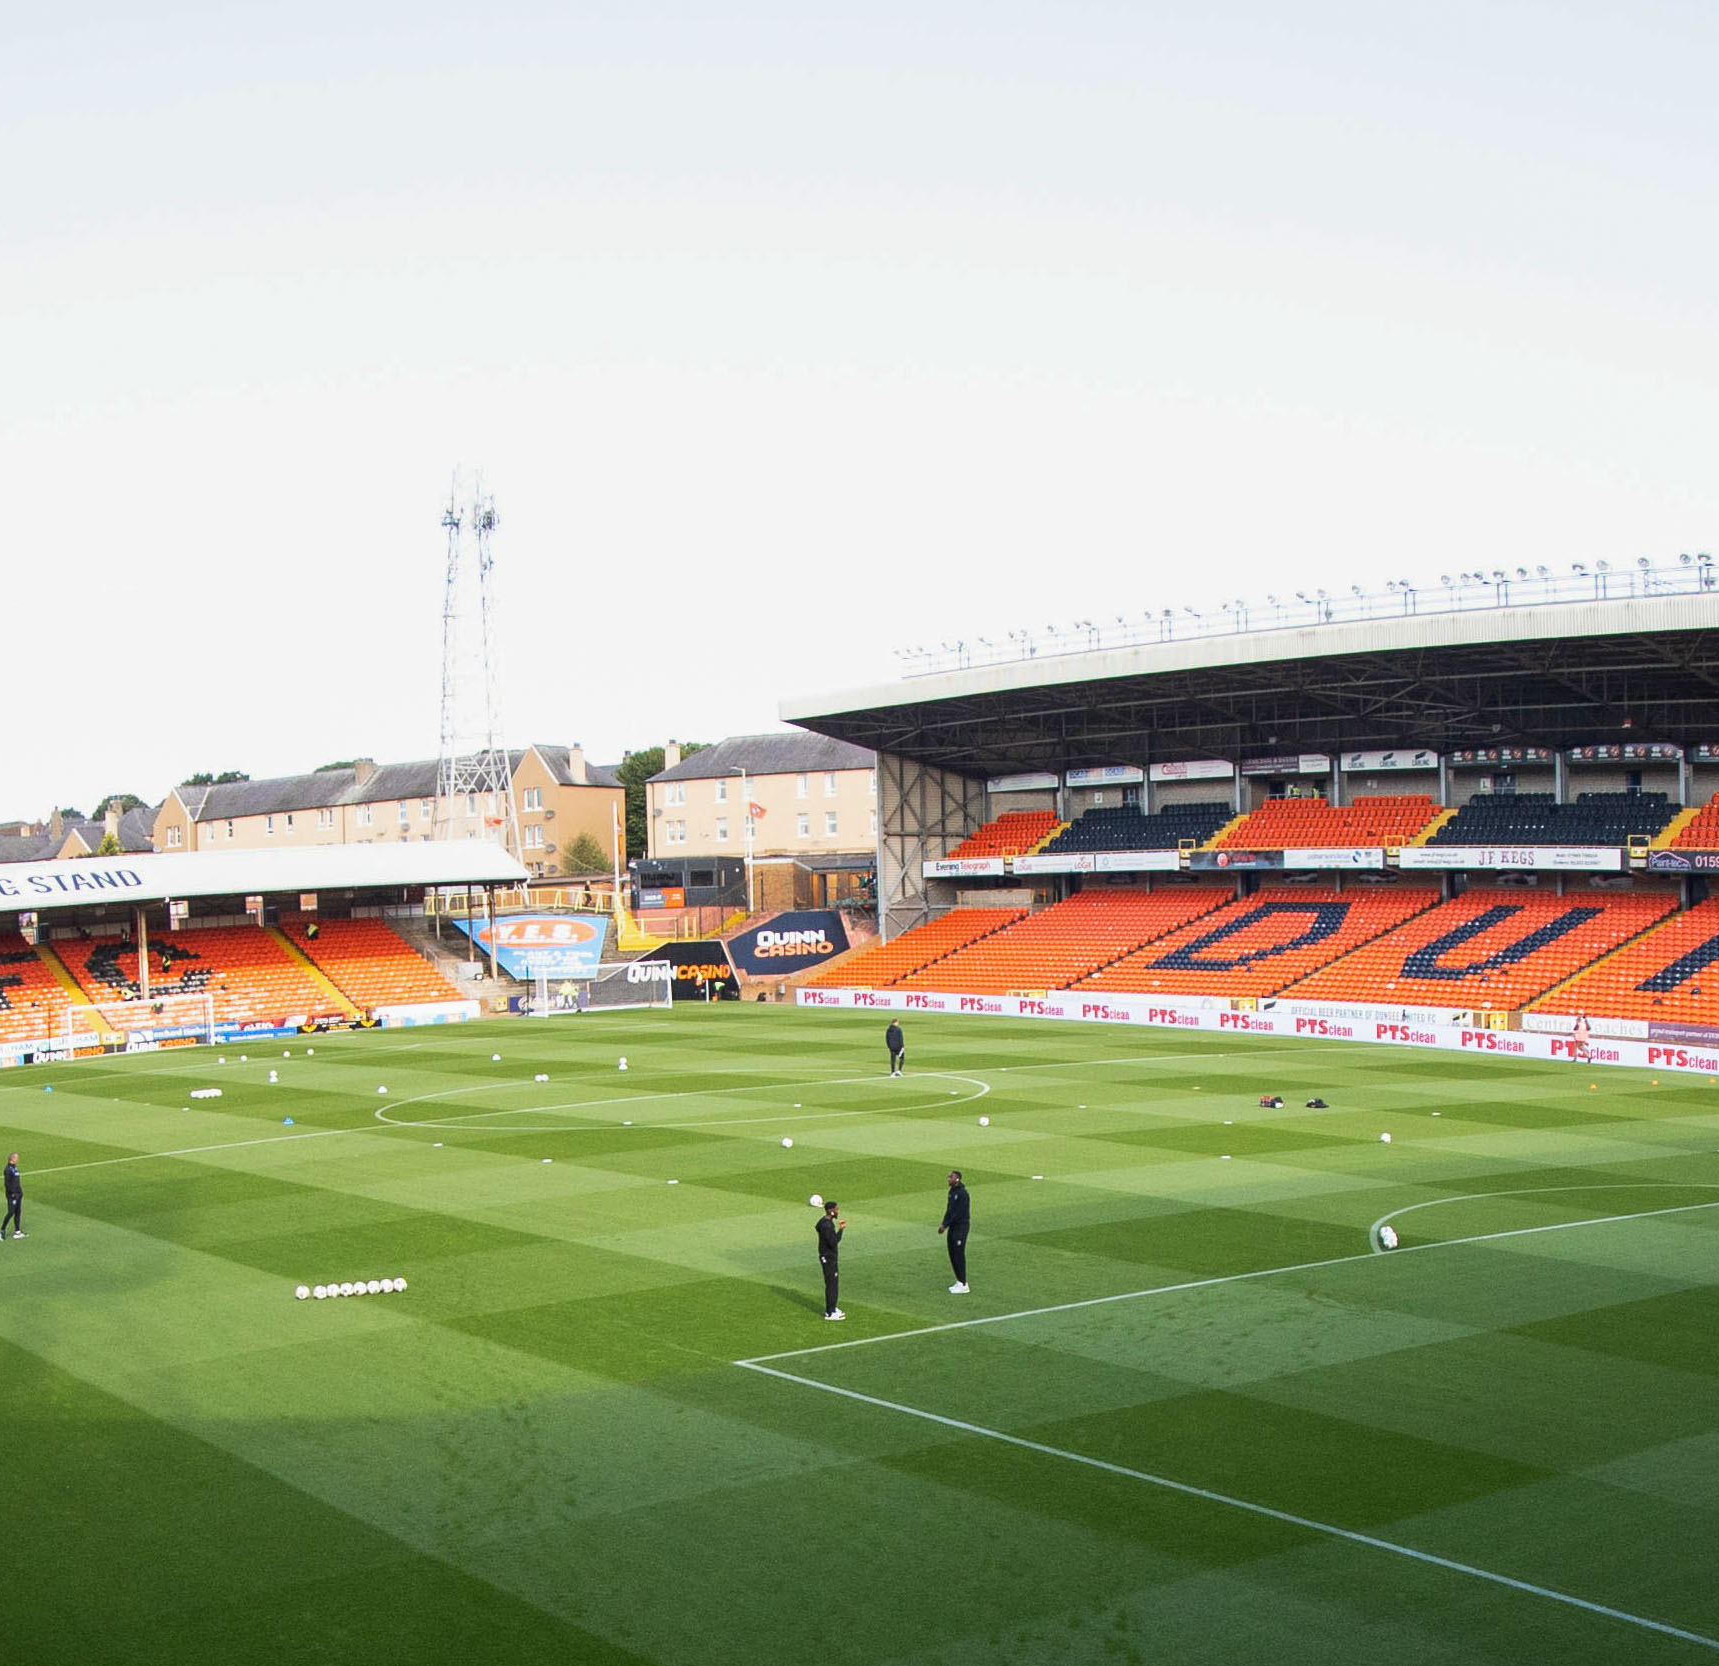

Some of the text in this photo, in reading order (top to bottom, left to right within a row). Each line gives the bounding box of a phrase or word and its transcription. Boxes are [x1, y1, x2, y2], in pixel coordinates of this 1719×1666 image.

[1501, 850, 1535, 865] KEGS
[936, 861, 991, 872] Evening Telegraph
[27, 868, 143, 894] STAND
[756, 929, 826, 947] QUINN
[753, 941, 834, 958] CASINO
[1290, 1006, 1316, 1016] OFFICIAL
[1318, 1007, 1334, 1017] BEER
[1335, 1009, 1363, 1020] PARTNER
[1375, 1011, 1401, 1021] DUNDEE
[1428, 1013, 1436, 1024] FC
